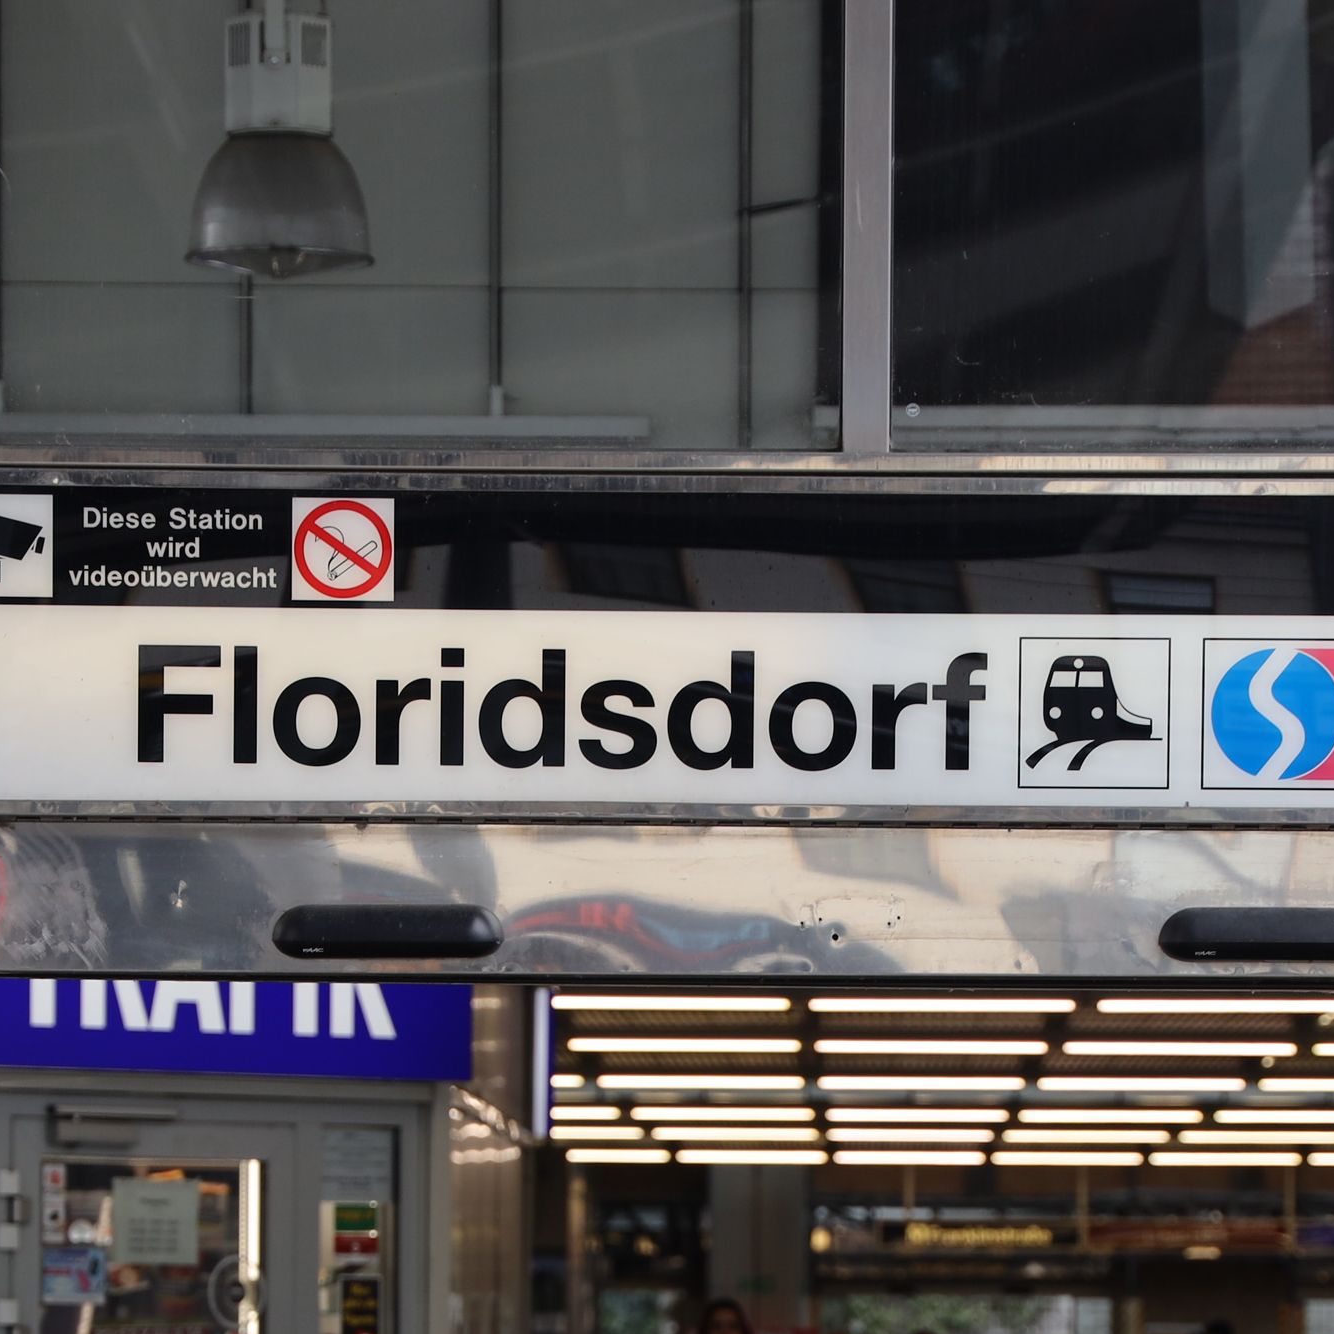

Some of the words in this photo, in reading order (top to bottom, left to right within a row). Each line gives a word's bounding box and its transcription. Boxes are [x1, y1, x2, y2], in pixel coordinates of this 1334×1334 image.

[82, 506, 157, 530] Diese
[168, 507, 264, 531] Station
[146, 536, 201, 560] wird
[68, 564, 278, 590] videoüberwacht
[137, 644, 989, 772] Floridsdorf
